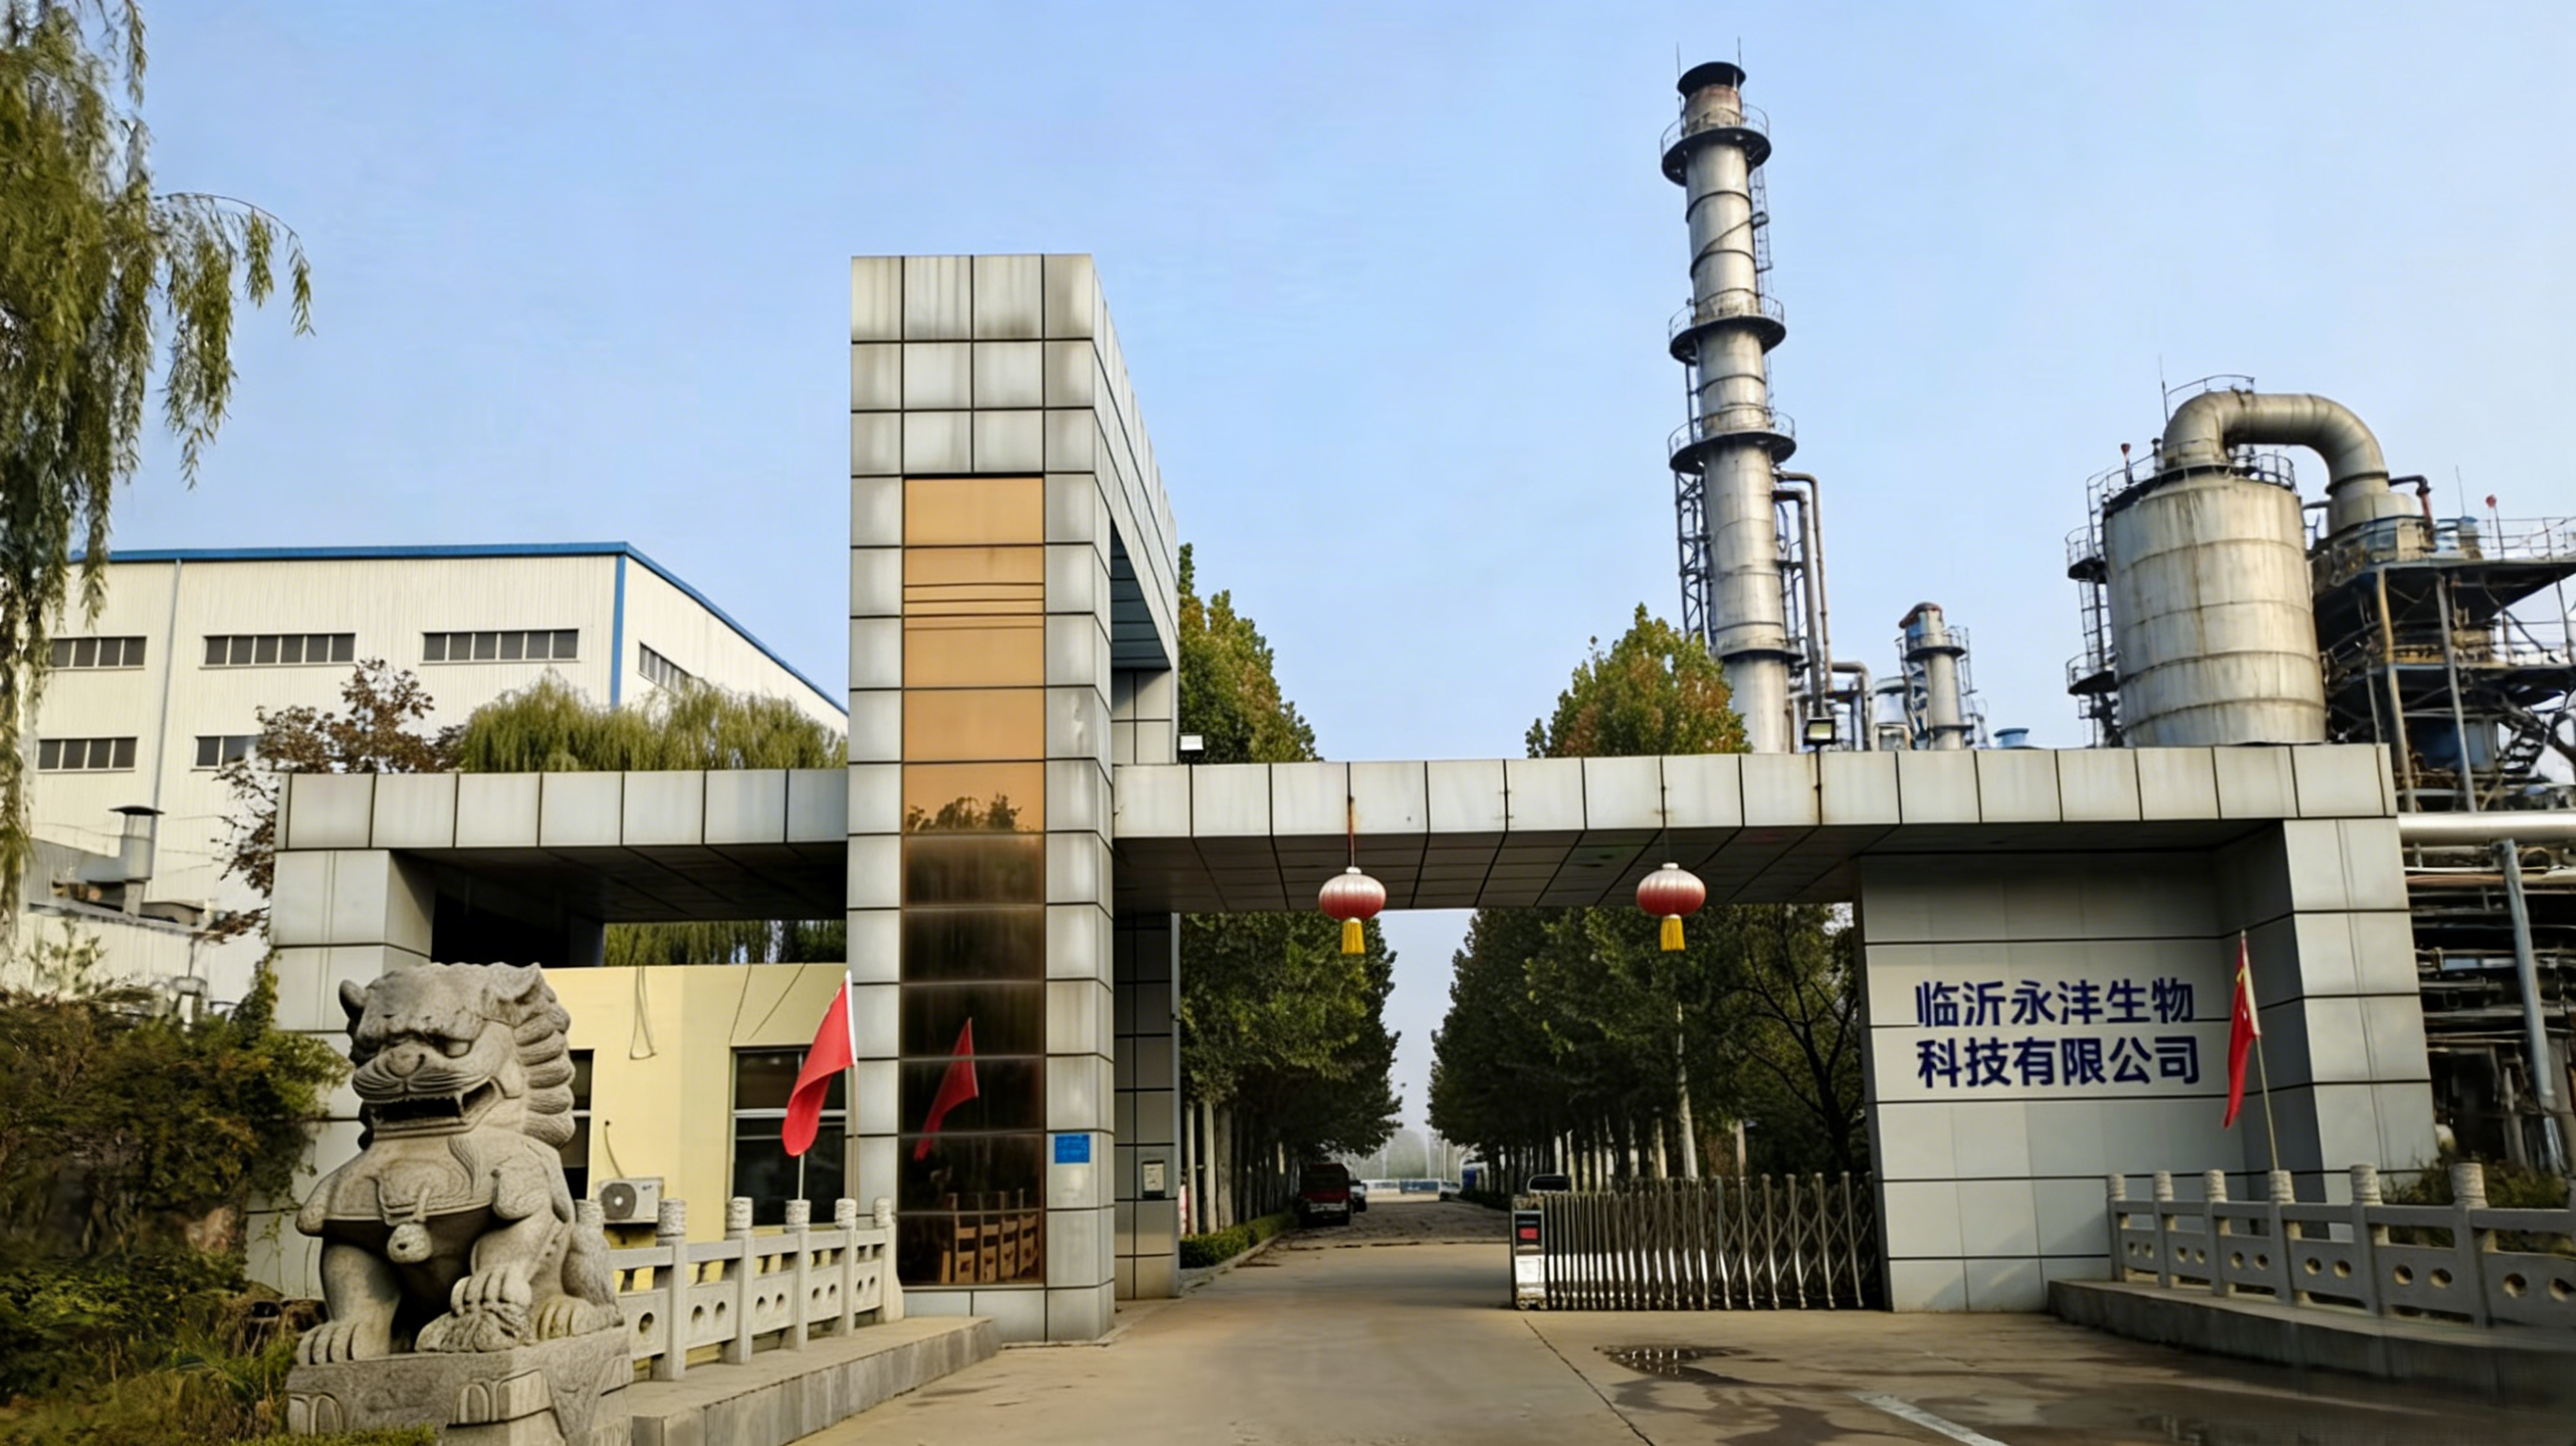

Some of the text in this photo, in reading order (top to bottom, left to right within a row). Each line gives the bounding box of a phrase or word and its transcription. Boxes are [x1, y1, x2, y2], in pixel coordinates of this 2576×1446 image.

[1915, 977, 2194, 1027] 临沂永沣生物
[1916, 1035, 2200, 1089] 科技有限公司
